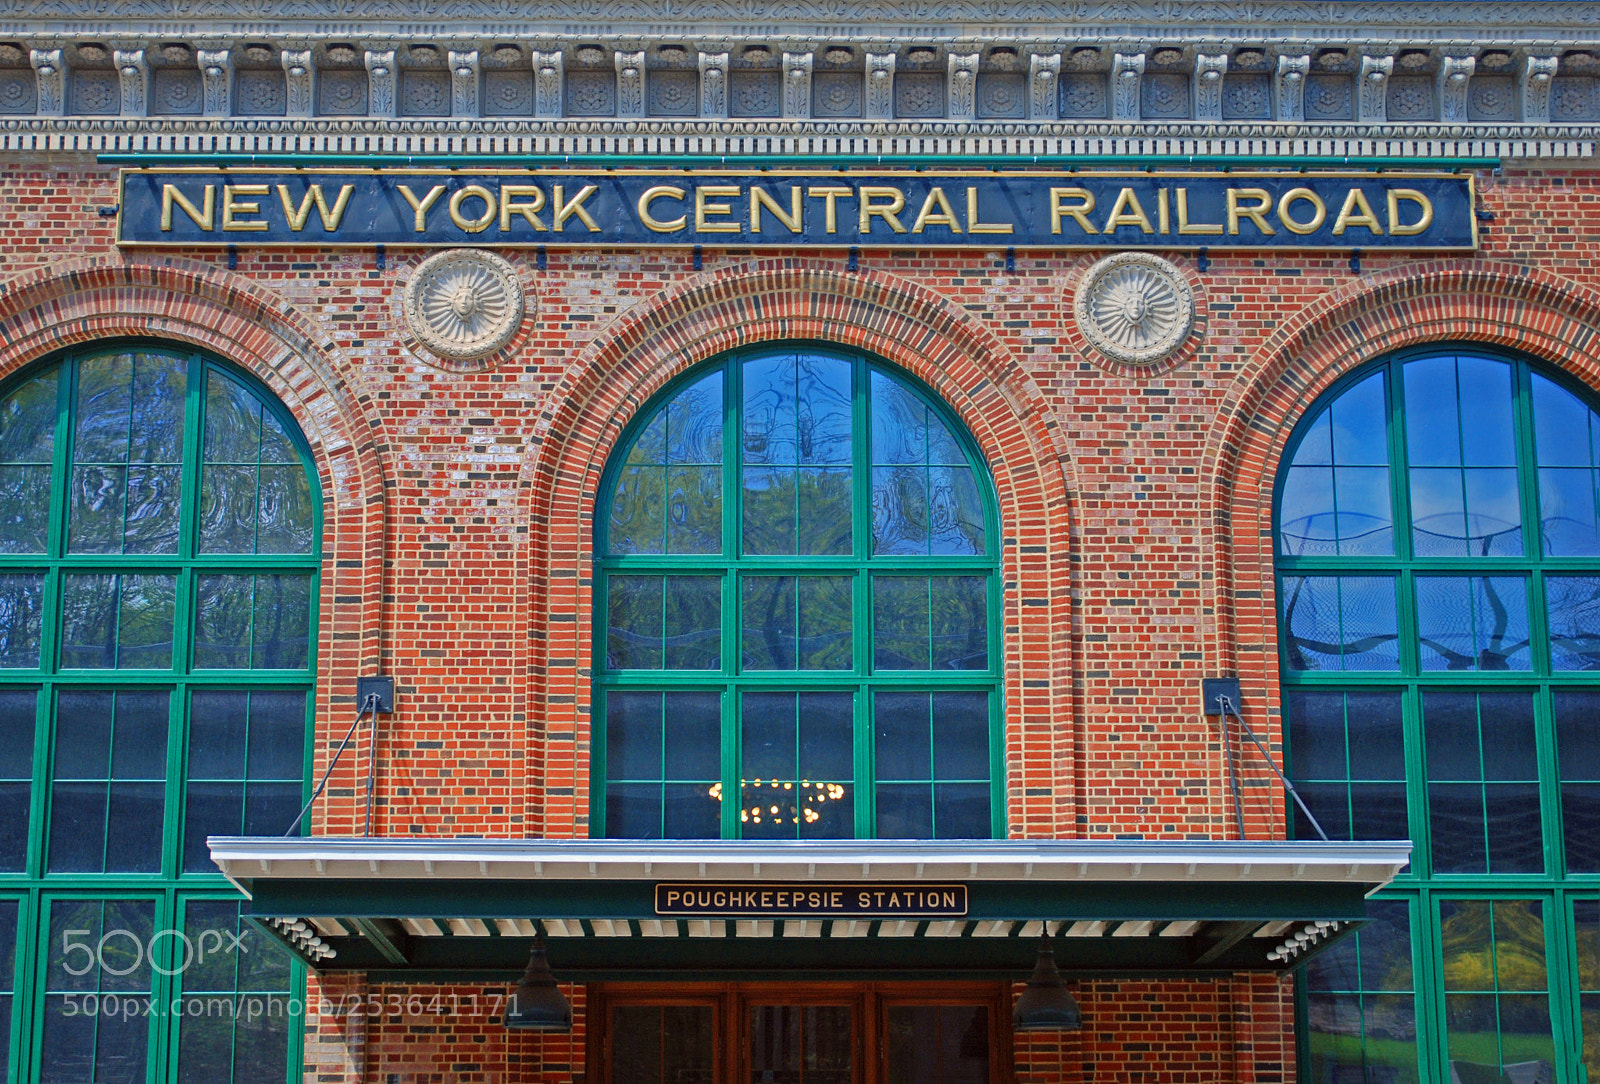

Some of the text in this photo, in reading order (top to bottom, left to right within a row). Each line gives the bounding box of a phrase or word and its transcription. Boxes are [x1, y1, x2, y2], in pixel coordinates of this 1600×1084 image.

[160, 183, 1433, 236] NEW YORK CENTRAL RAILROAD
[667, 891, 956, 908] POUGHKEEPSIE STATION
